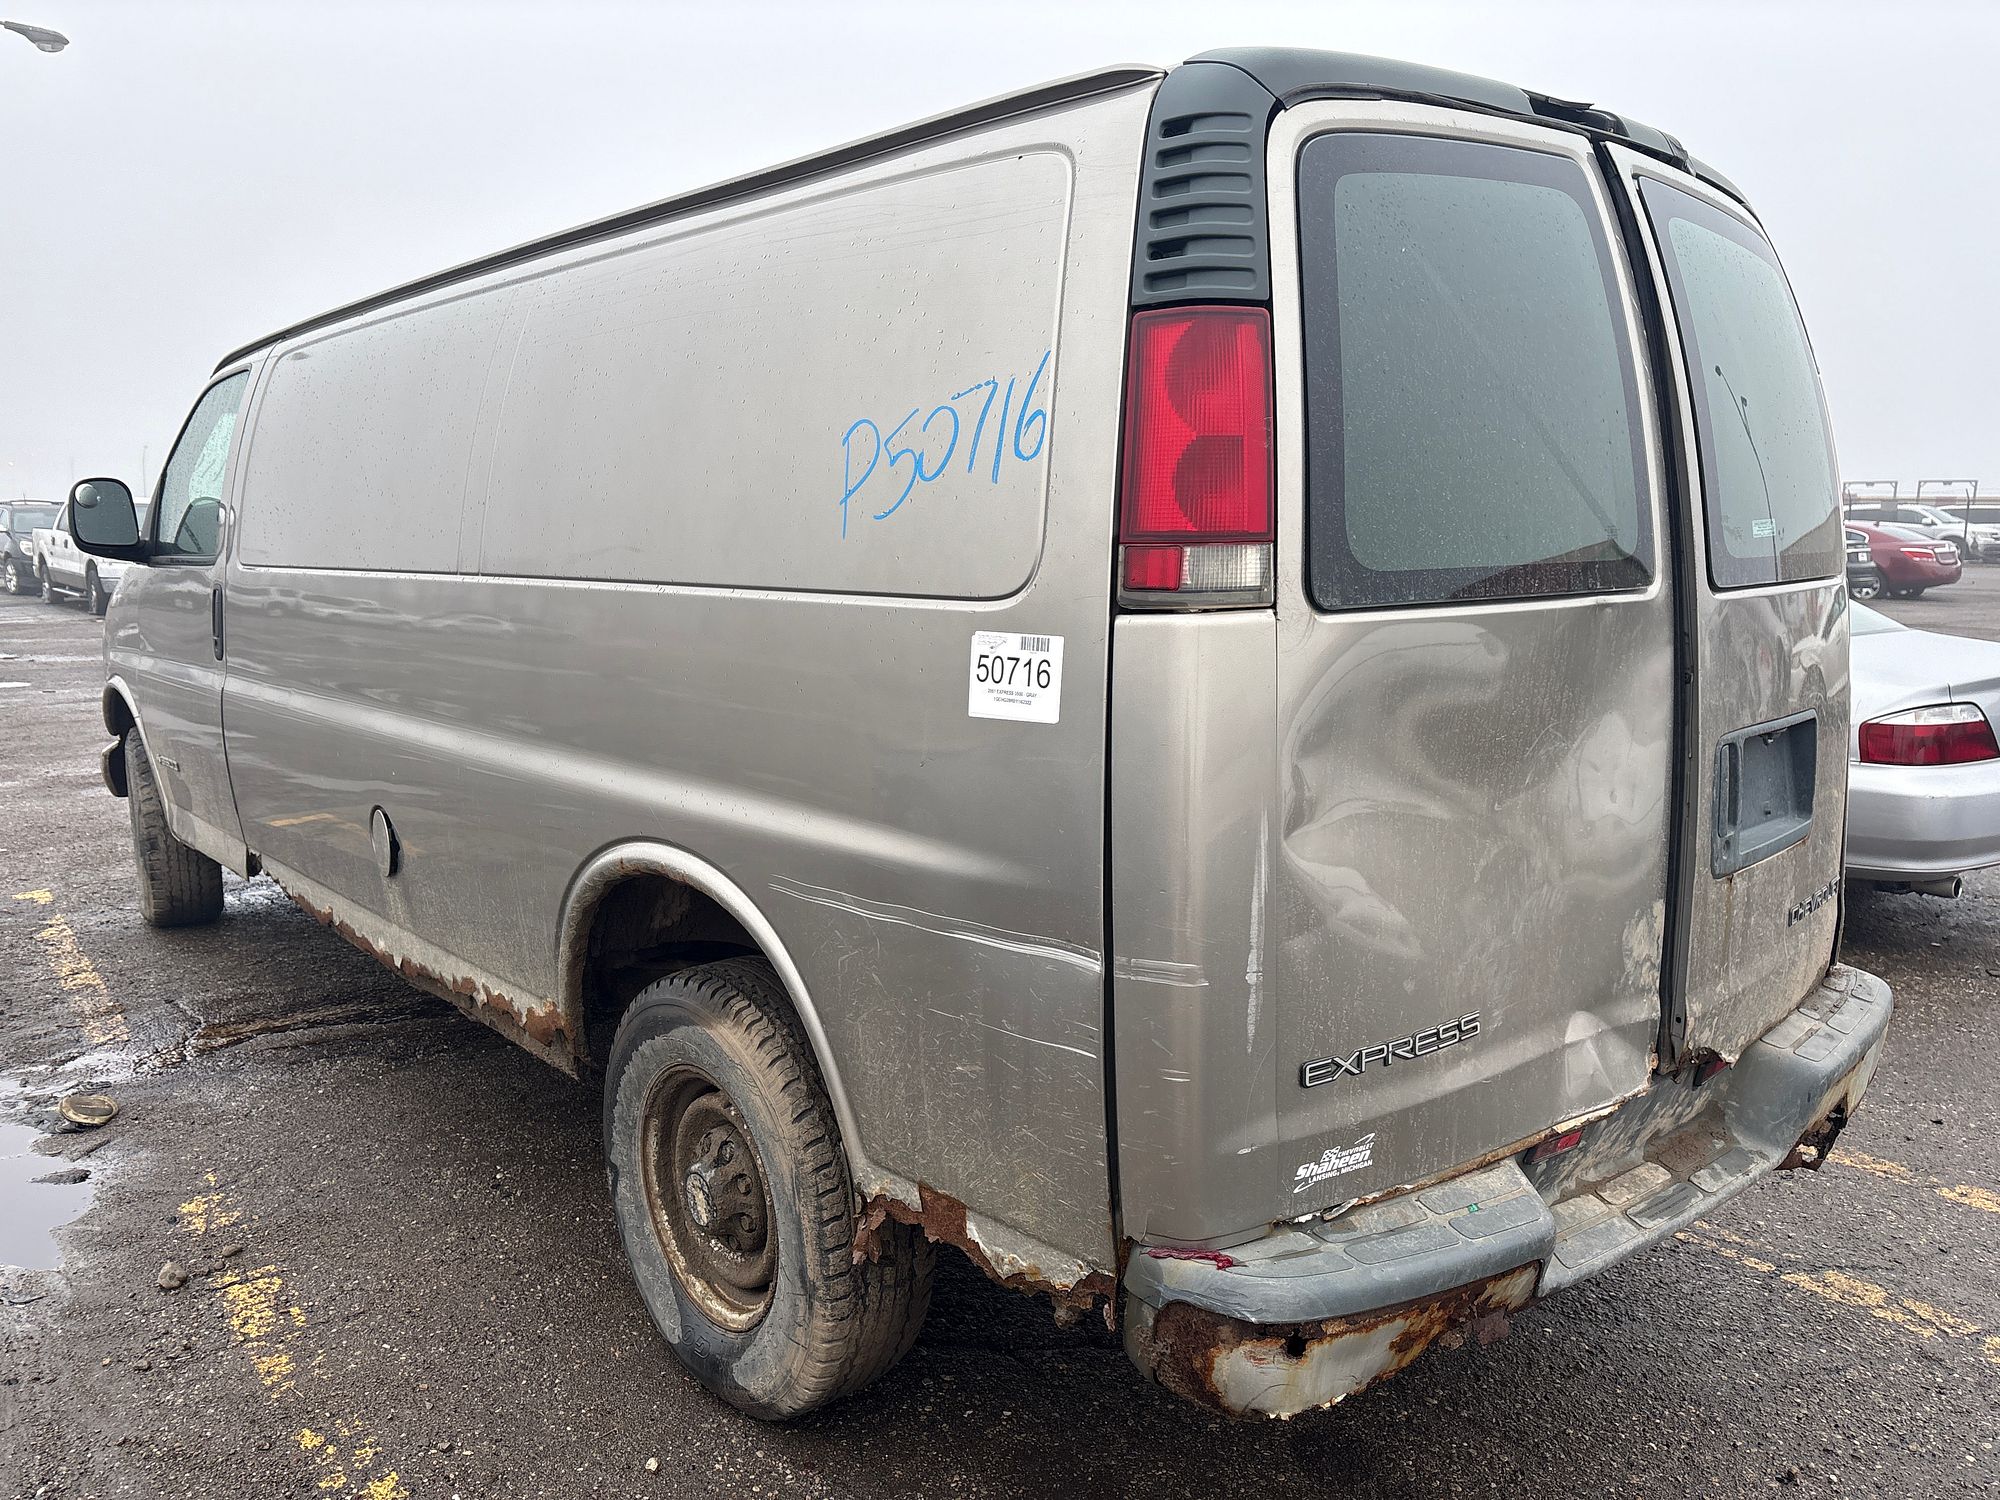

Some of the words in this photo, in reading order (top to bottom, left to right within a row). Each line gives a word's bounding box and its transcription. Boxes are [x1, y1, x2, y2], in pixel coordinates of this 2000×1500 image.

[839, 350, 1052, 540] P50716
[976, 654, 1051, 689] 50716
[1299, 1010, 1481, 1089] EXPRESS
[1294, 1149, 1372, 1181] Shaheen
[1338, 1142, 1375, 1158] CHEVROLET
[1308, 1169, 1340, 1184] LANSING,
[1340, 1159, 1373, 1175] MICHIGAN
